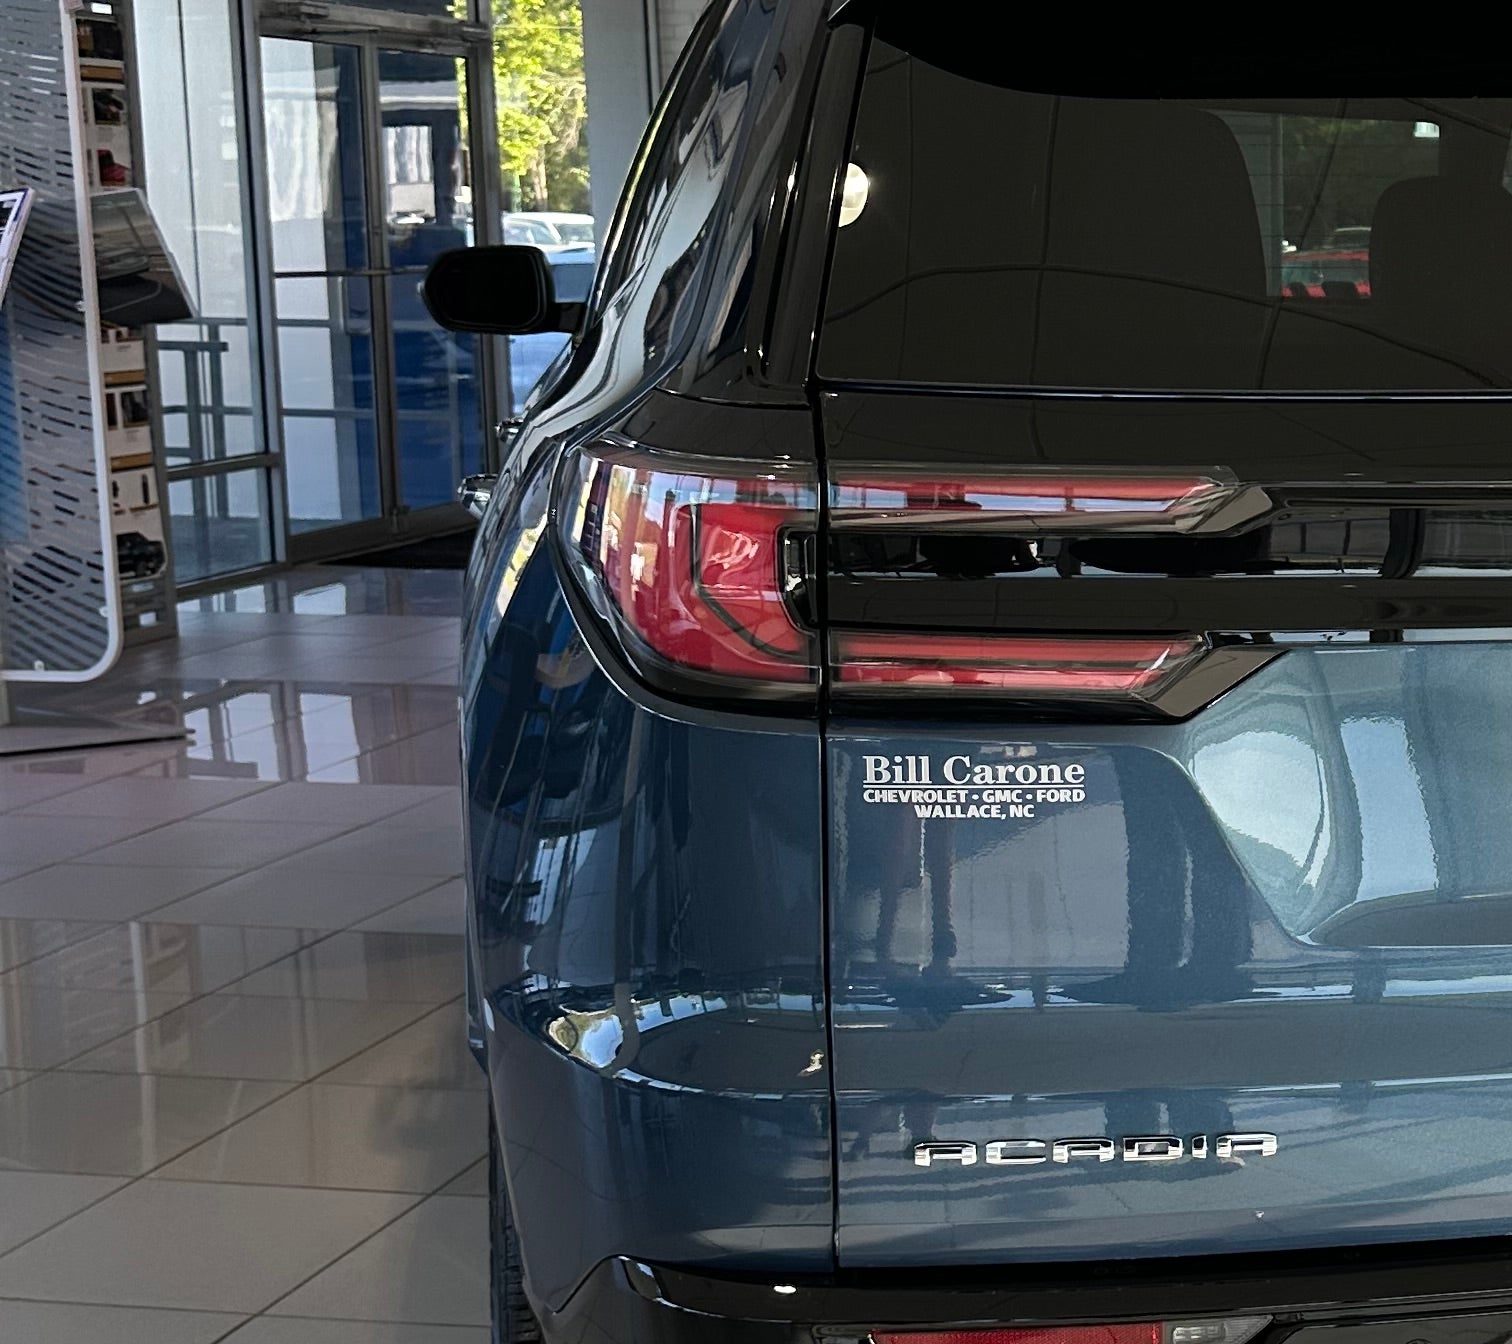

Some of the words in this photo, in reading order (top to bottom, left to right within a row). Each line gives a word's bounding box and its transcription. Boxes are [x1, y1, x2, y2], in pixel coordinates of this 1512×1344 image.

[862, 754, 933, 785] Bill
[943, 754, 1085, 785] Carone
[862, 788, 968, 803] CHEVROLET
[982, 788, 1023, 803] GMC
[1036, 788, 1085, 803] FORD
[914, 804, 1007, 820] WALLACE,
[1010, 804, 1035, 818] NC
[914, 1131, 1279, 1168] ACADIA
